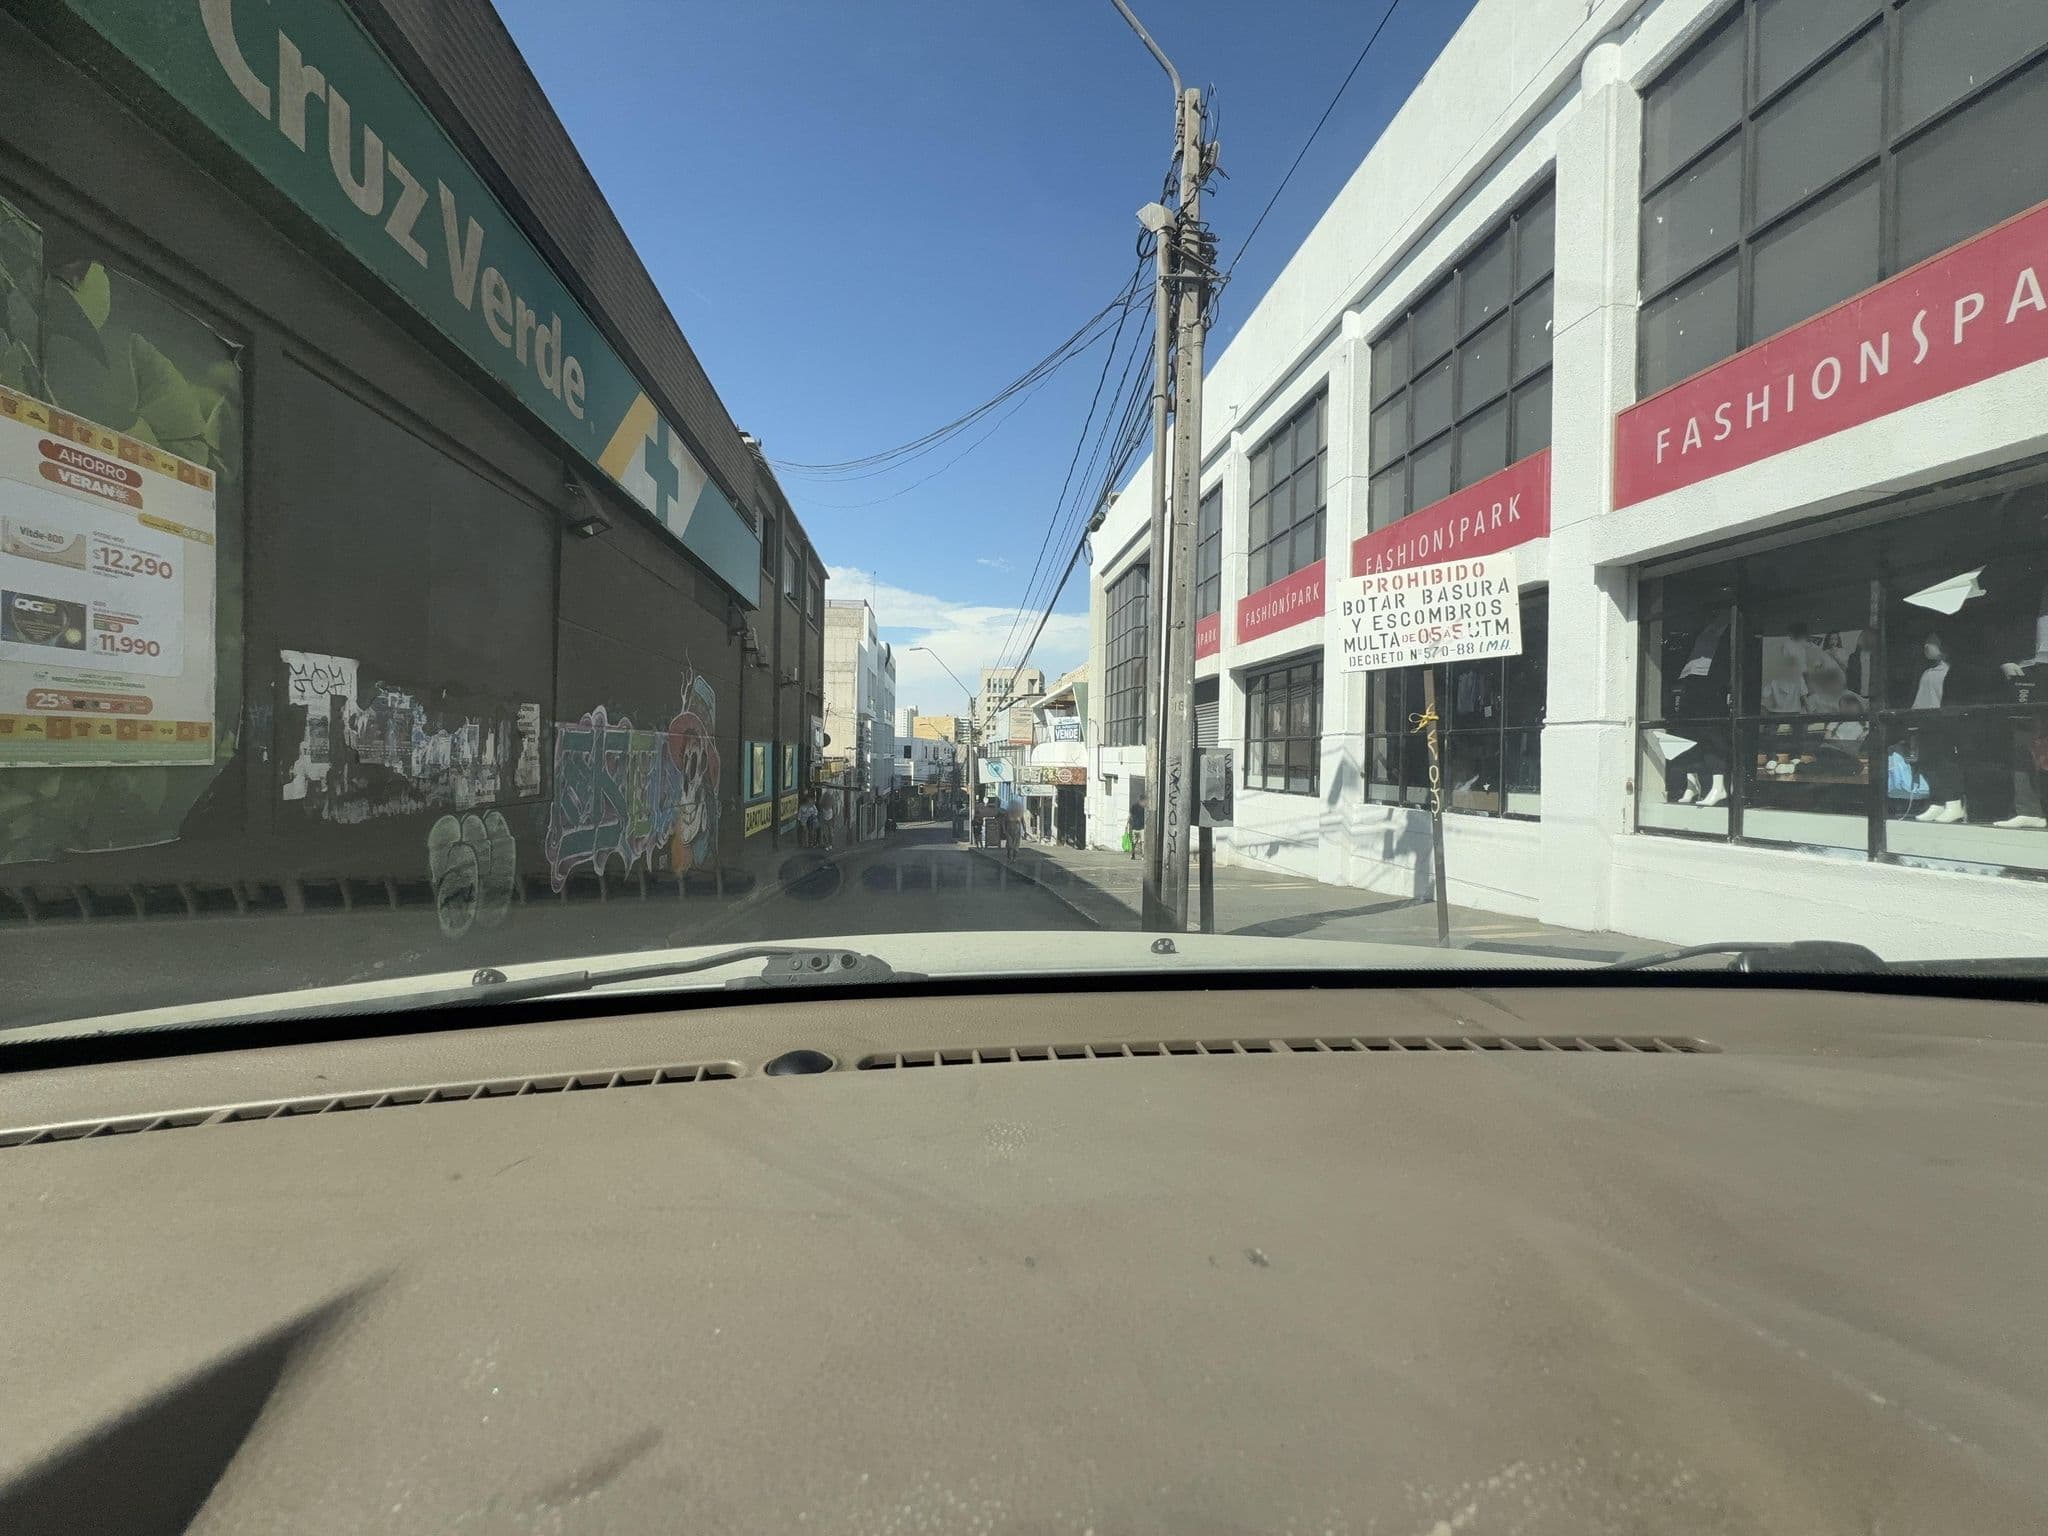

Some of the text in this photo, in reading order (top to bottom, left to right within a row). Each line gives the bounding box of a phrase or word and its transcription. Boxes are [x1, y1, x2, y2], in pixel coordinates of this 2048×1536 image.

[200, 0, 585, 420] Cruz Verde
[59, 448, 128, 482] AHORRO
[93, 547, 173, 580] $12.290
[1363, 562, 1485, 595] PROHIBIDO
[1343, 577, 1509, 616] BOTAR BASURA
[1352, 599, 1502, 633] Y ESCOMBROS
[1344, 632, 1400, 653] MULTA
[1402, 634, 1416, 643] DE
[1452, 623, 1463, 639] 5
[1349, 651, 1403, 667] DECRETO
[1424, 643, 1475, 659] 570-88
[1055, 728, 1078, 739] VENDE
